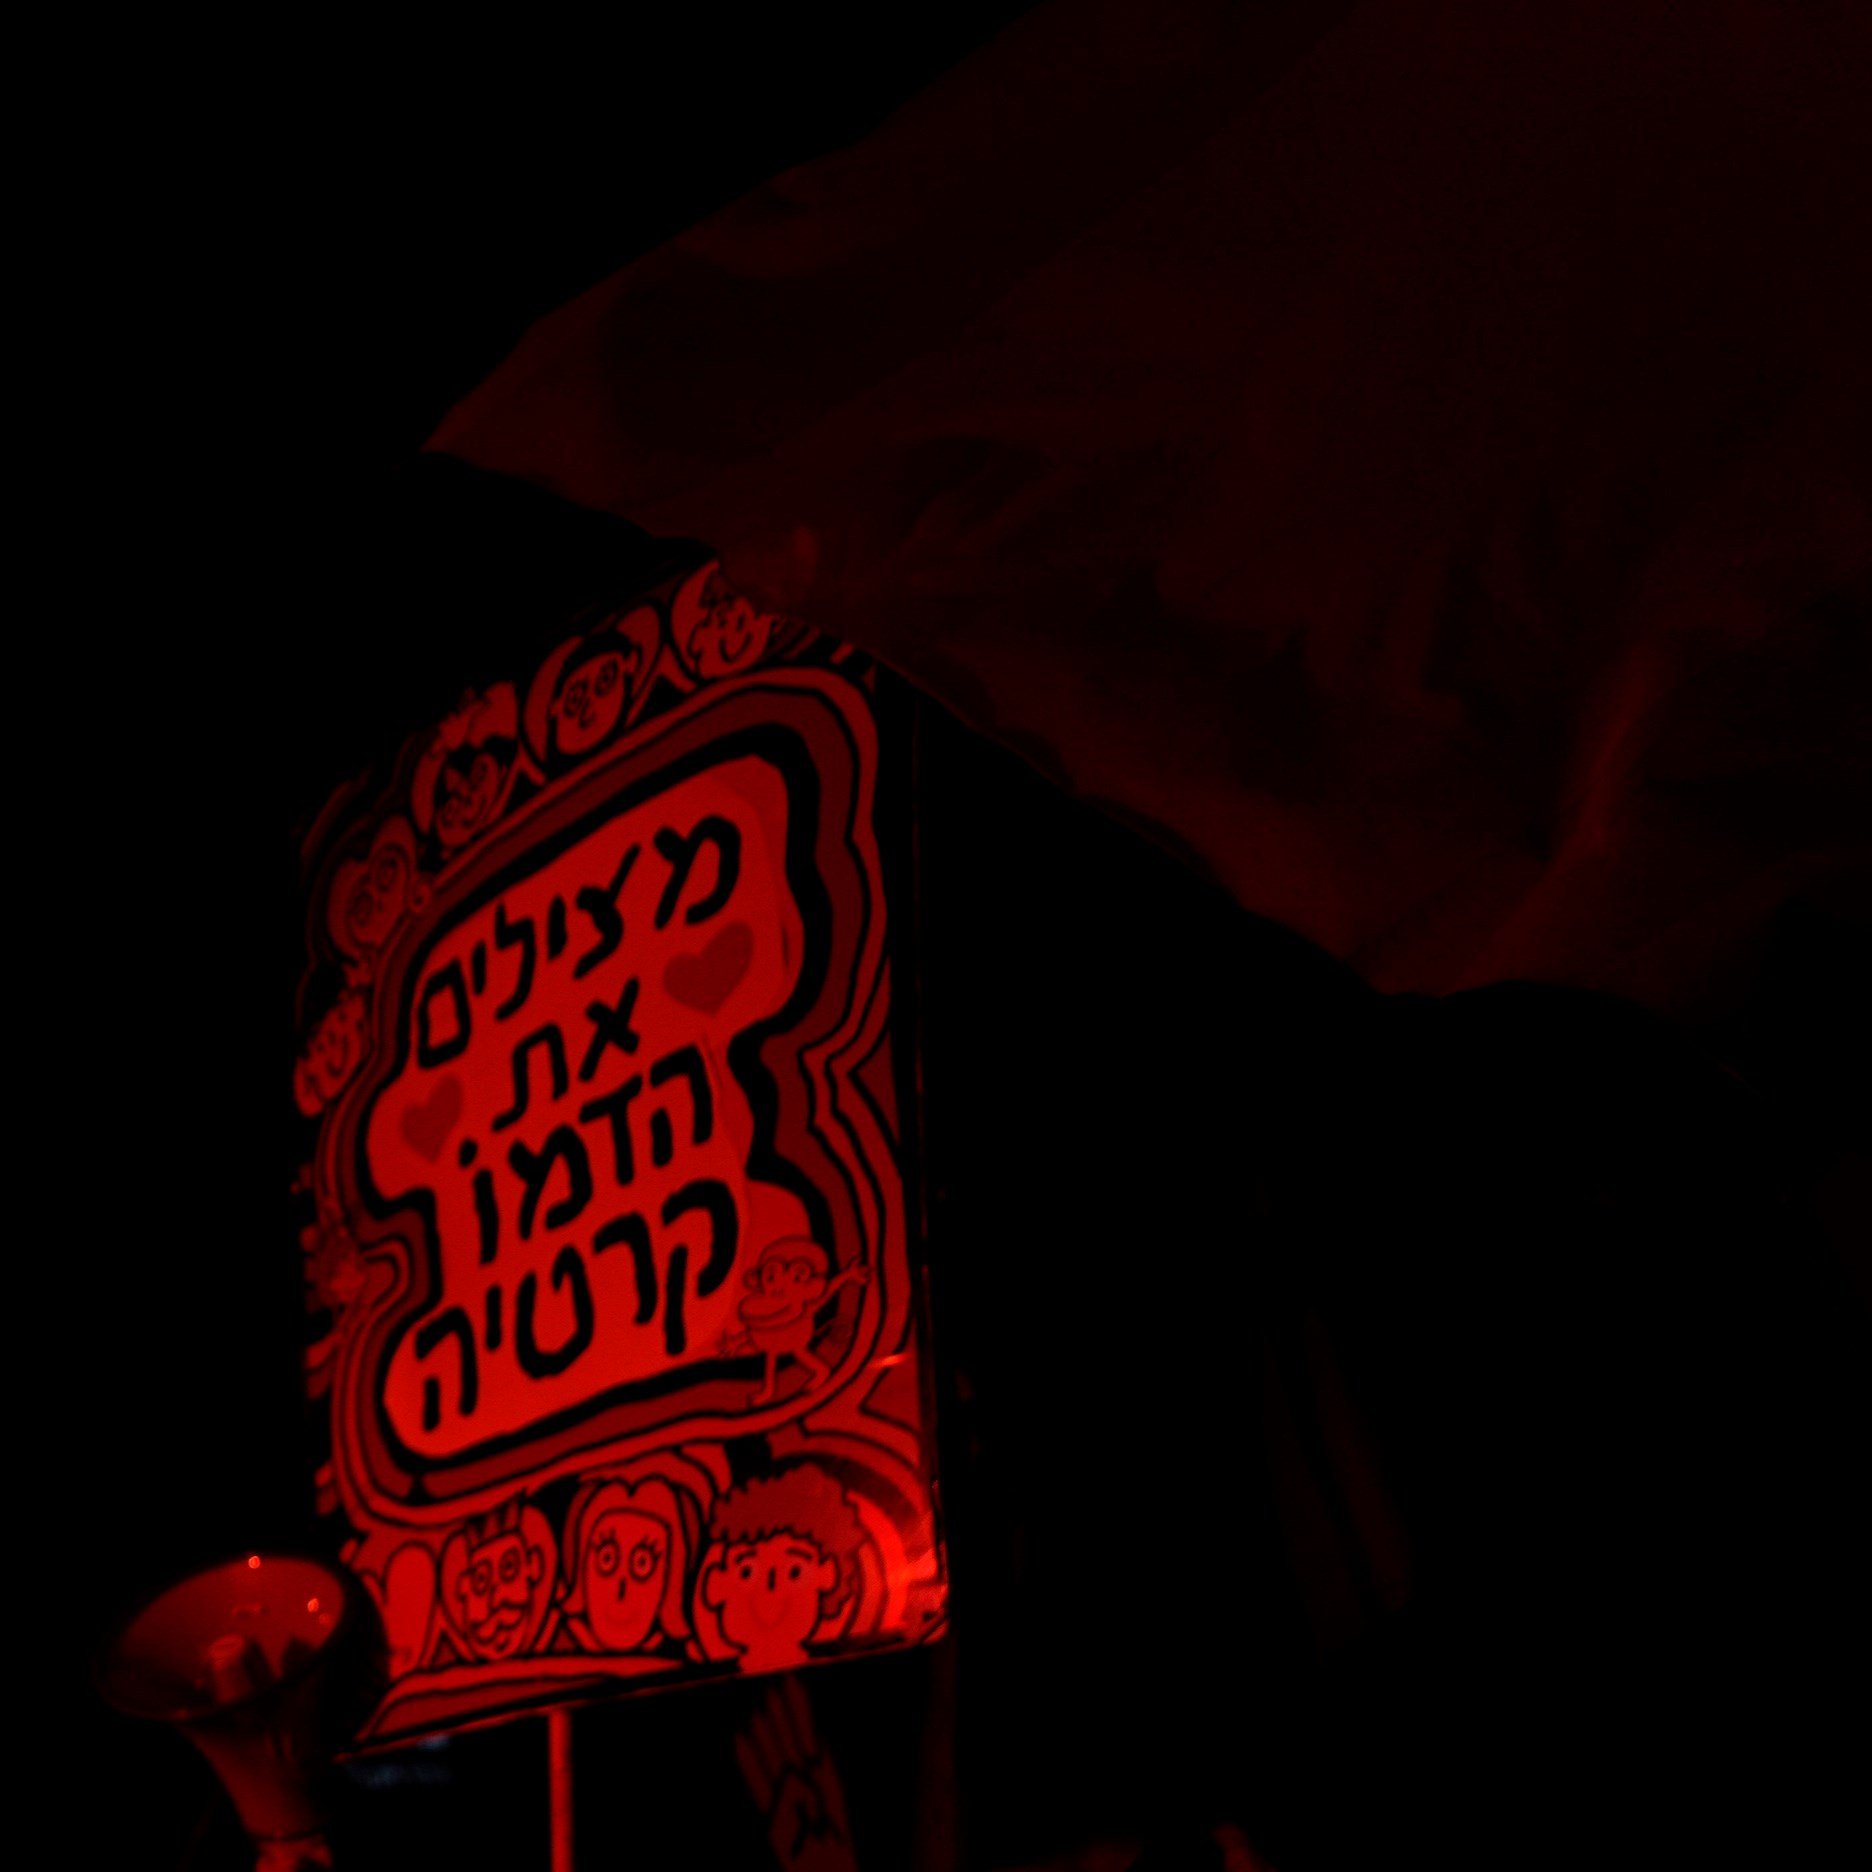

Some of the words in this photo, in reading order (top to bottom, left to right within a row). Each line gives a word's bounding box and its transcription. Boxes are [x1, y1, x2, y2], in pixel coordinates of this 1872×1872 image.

[418, 818, 739, 1066] מצילים
[494, 979, 640, 1129] את
[417, 1180, 738, 1430] קרטיה
